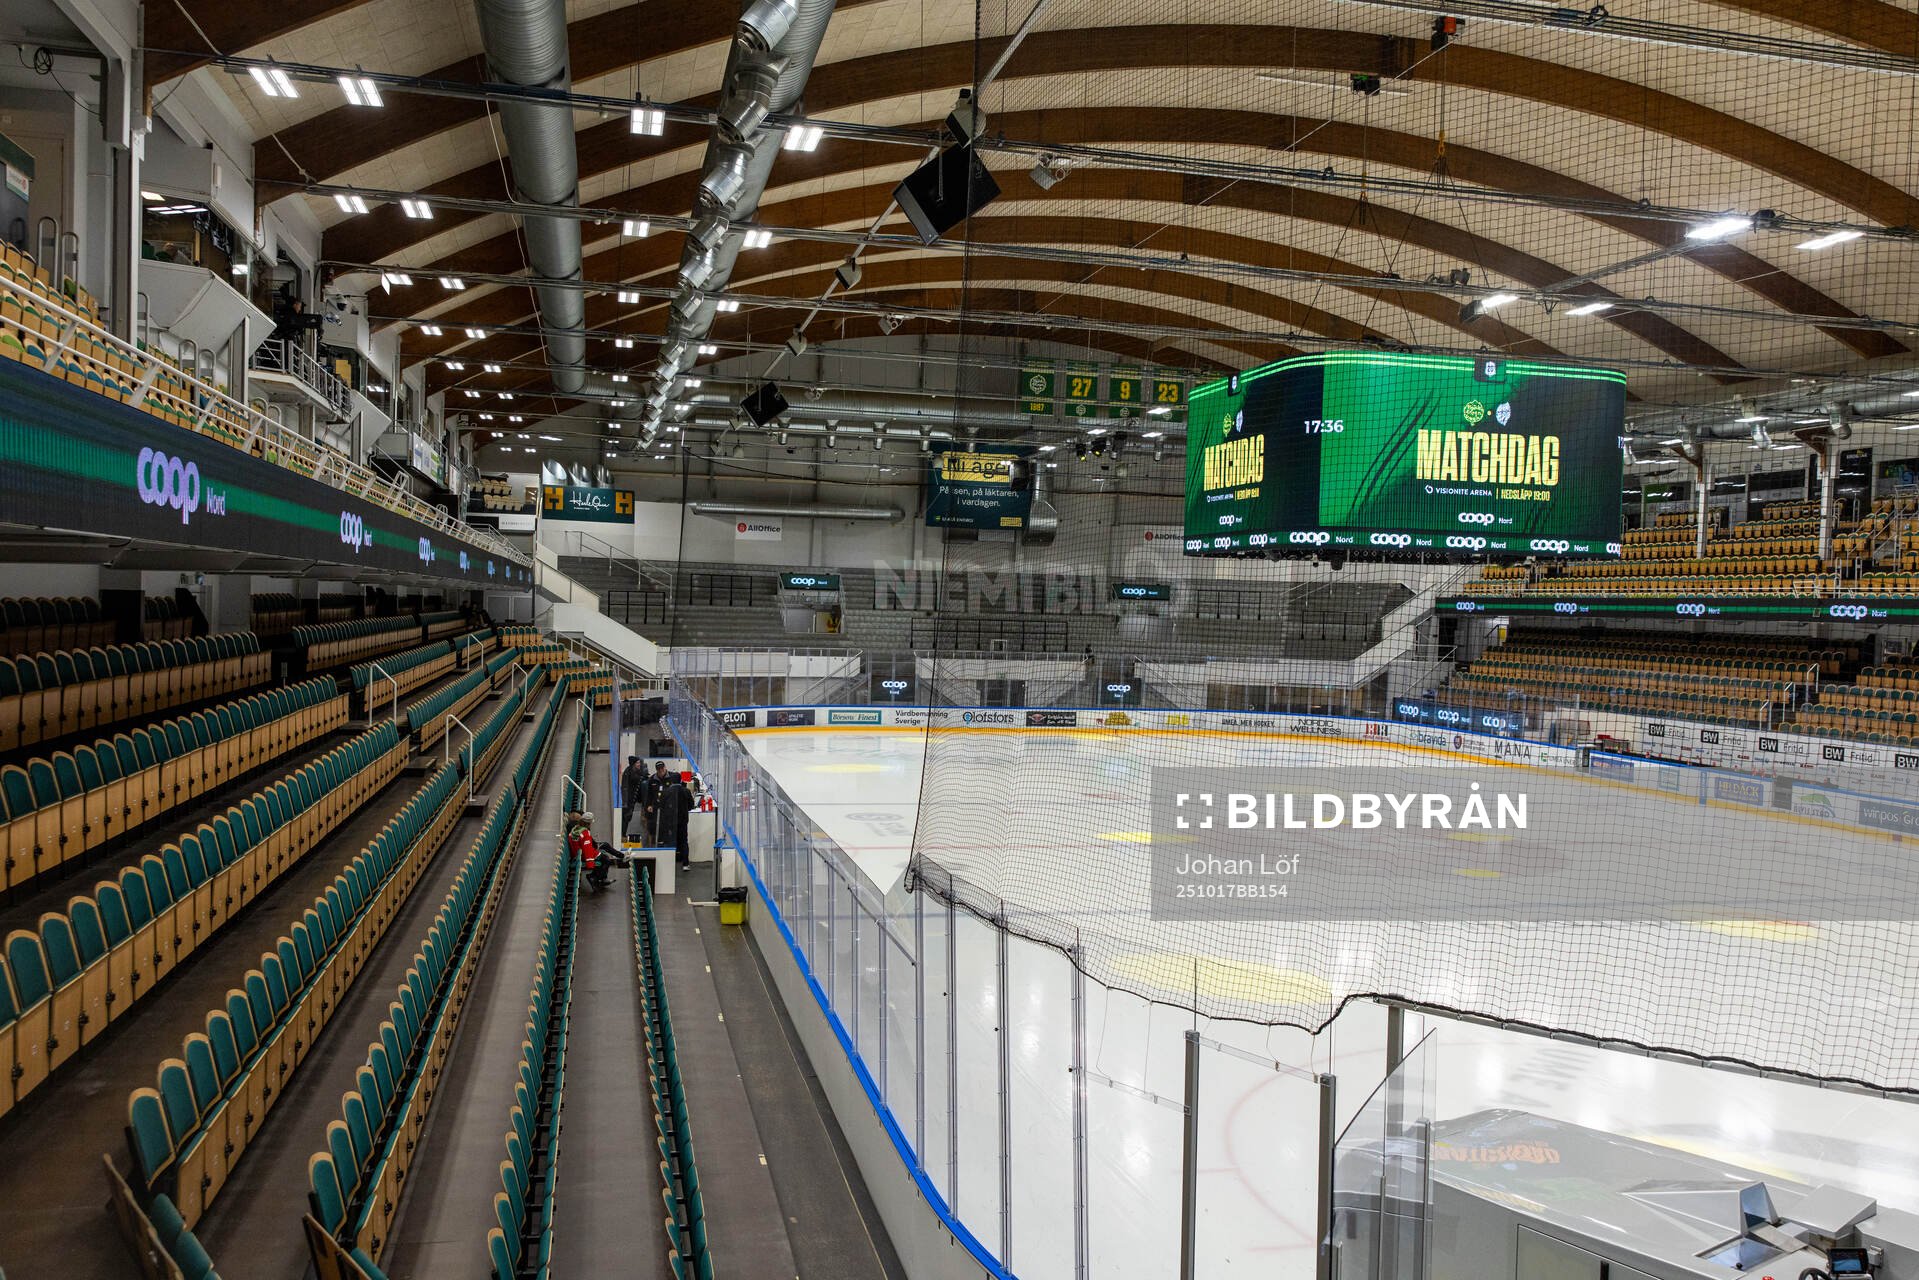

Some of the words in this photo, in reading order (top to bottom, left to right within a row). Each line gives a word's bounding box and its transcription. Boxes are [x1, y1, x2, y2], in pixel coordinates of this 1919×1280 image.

[1072, 378, 1092, 398] 27
[1120, 381, 1131, 400] 9
[1158, 383, 1179, 402] 23
[1304, 420, 1344, 434] 17:36
[1204, 434, 1264, 491] MATCHDAG
[1416, 429, 1560, 486] MATCHDAG
[137, 447, 199, 525] coop
[1435, 488, 1469, 496] VISIONITE
[1470, 489, 1492, 497] ARENA
[1219, 515, 1235, 526] coop
[1458, 512, 1495, 526] coop
[340, 511, 362, 554] coop
[748, 524, 781, 533] AllOffice
[1187, 539, 1202, 552] coop
[1214, 536, 1231, 550] coop
[1249, 534, 1268, 547] coop
[1289, 531, 1330, 546] coop
[1336, 535, 1353, 543] Nord
[1370, 533, 1411, 548] coop
[1416, 538, 1432, 546] Nord
[1446, 536, 1487, 551] coop
[1491, 541, 1506, 549] Nord
[1530, 539, 1570, 554] coop
[1573, 544, 1589, 552] Nord
[791, 577, 816, 587] coop
[1122, 588, 1147, 596] coop
[1456, 602, 1475, 612] coop
[1554, 603, 1577, 615] coop
[1676, 603, 1705, 617] coop
[1829, 605, 1868, 620] coop
[1872, 609, 1887, 618] Nord
[882, 680, 908, 690] coop
[1107, 684, 1131, 693] coop
[962, 711, 1014, 725] Olofsfors
[1399, 704, 1419, 718] coop
[1438, 709, 1460, 724] coop
[895, 718, 921, 726] Sverige
[1298, 718, 1334, 728] NORDIC
[1290, 725, 1342, 736] WELLNESS
[1650, 725, 1664, 736] BW
[1703, 731, 1718, 743] BW
[1760, 739, 1777, 751] BW
[1824, 747, 1843, 760] BW
[1850, 751, 1873, 763] Fritid
[1897, 756, 1918, 768] BW
[1863, 806, 1899, 823] winpos
